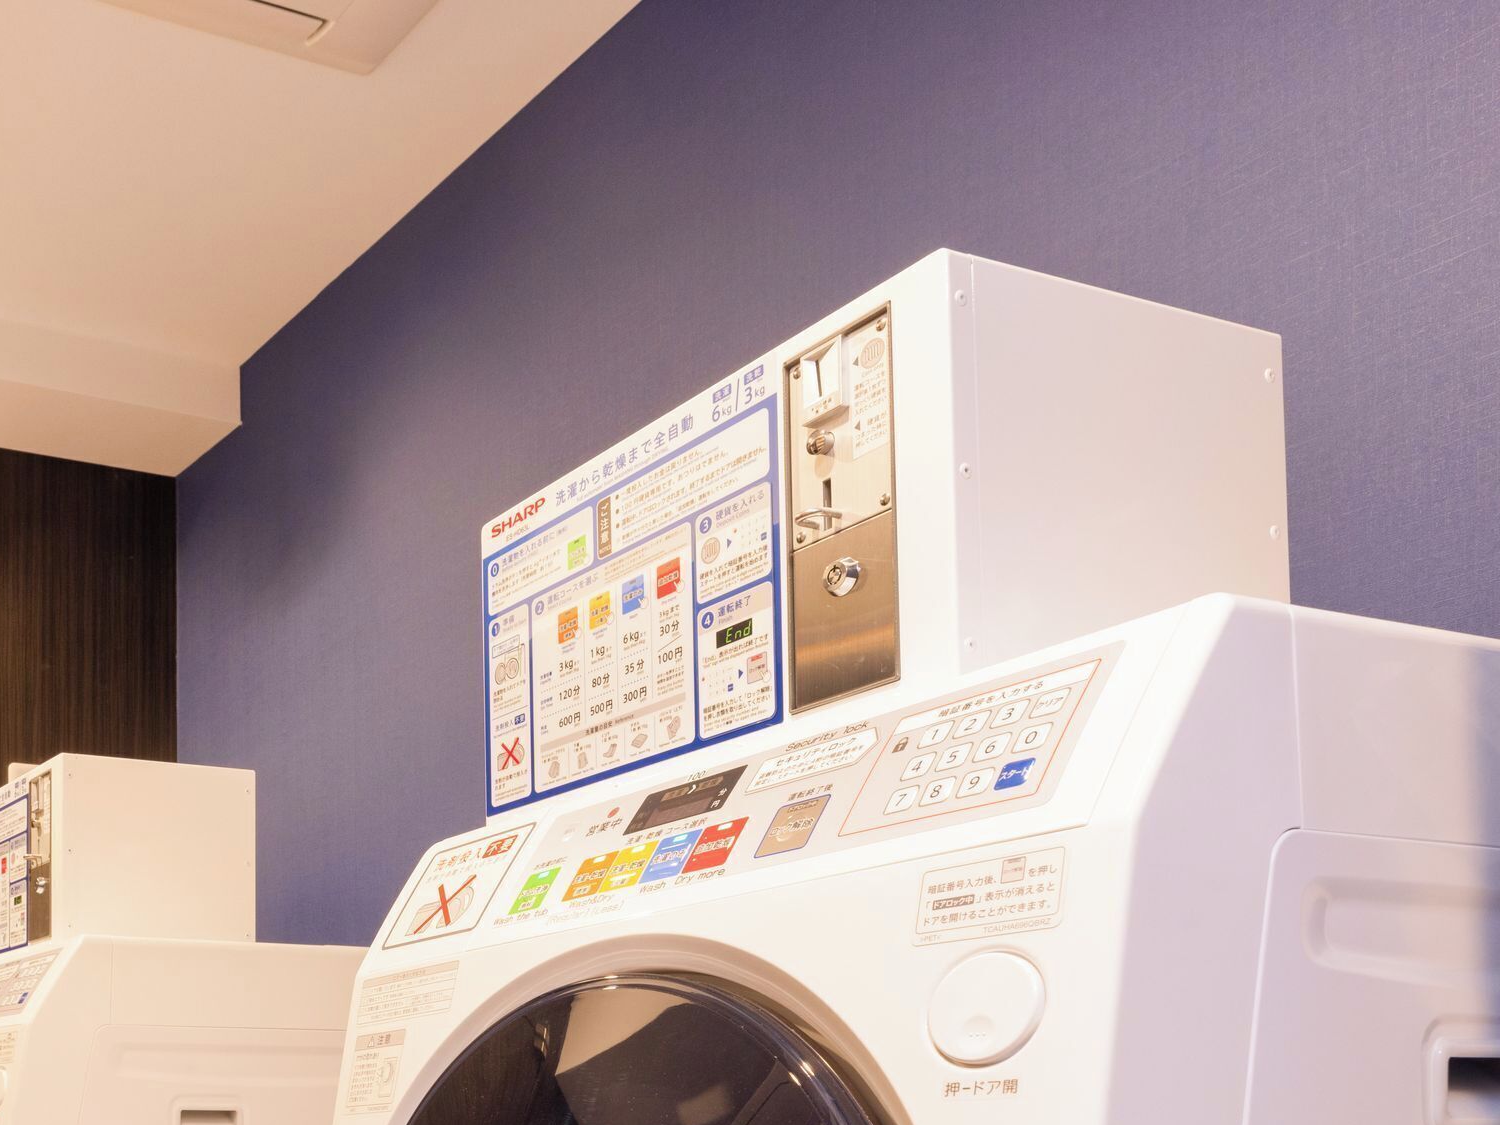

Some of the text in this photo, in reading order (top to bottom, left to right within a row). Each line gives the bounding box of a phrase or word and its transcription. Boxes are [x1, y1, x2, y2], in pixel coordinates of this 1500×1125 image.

[555, 411, 694, 507] 洗濯から乾燥まで全自動
[715, 487, 764, 523] 硬貨を入れる
[491, 495, 545, 540] SHARP
[717, 592, 751, 619] 運転終了
[659, 617, 680, 638] 30分
[724, 619, 751, 645] End
[624, 656, 644, 677] 35分
[657, 643, 682, 667] 100円
[591, 670, 610, 690] 80分
[558, 683, 580, 703] 120分
[622, 683, 647, 706] 300円
[938, 681, 1044, 719] 暗証番号を入力する
[558, 709, 580, 730] 600円
[589, 697, 613, 719] 500円
[786, 721, 868, 751] Security lock
[776, 737, 856, 767] セキュリティロック
[486, 838, 515, 857] 不要
[675, 868, 725, 886] Dry more
[1028, 864, 1058, 878] を押し
[639, 880, 667, 894] Wash
[923, 899, 1051, 926] ドアを開けることができます。
